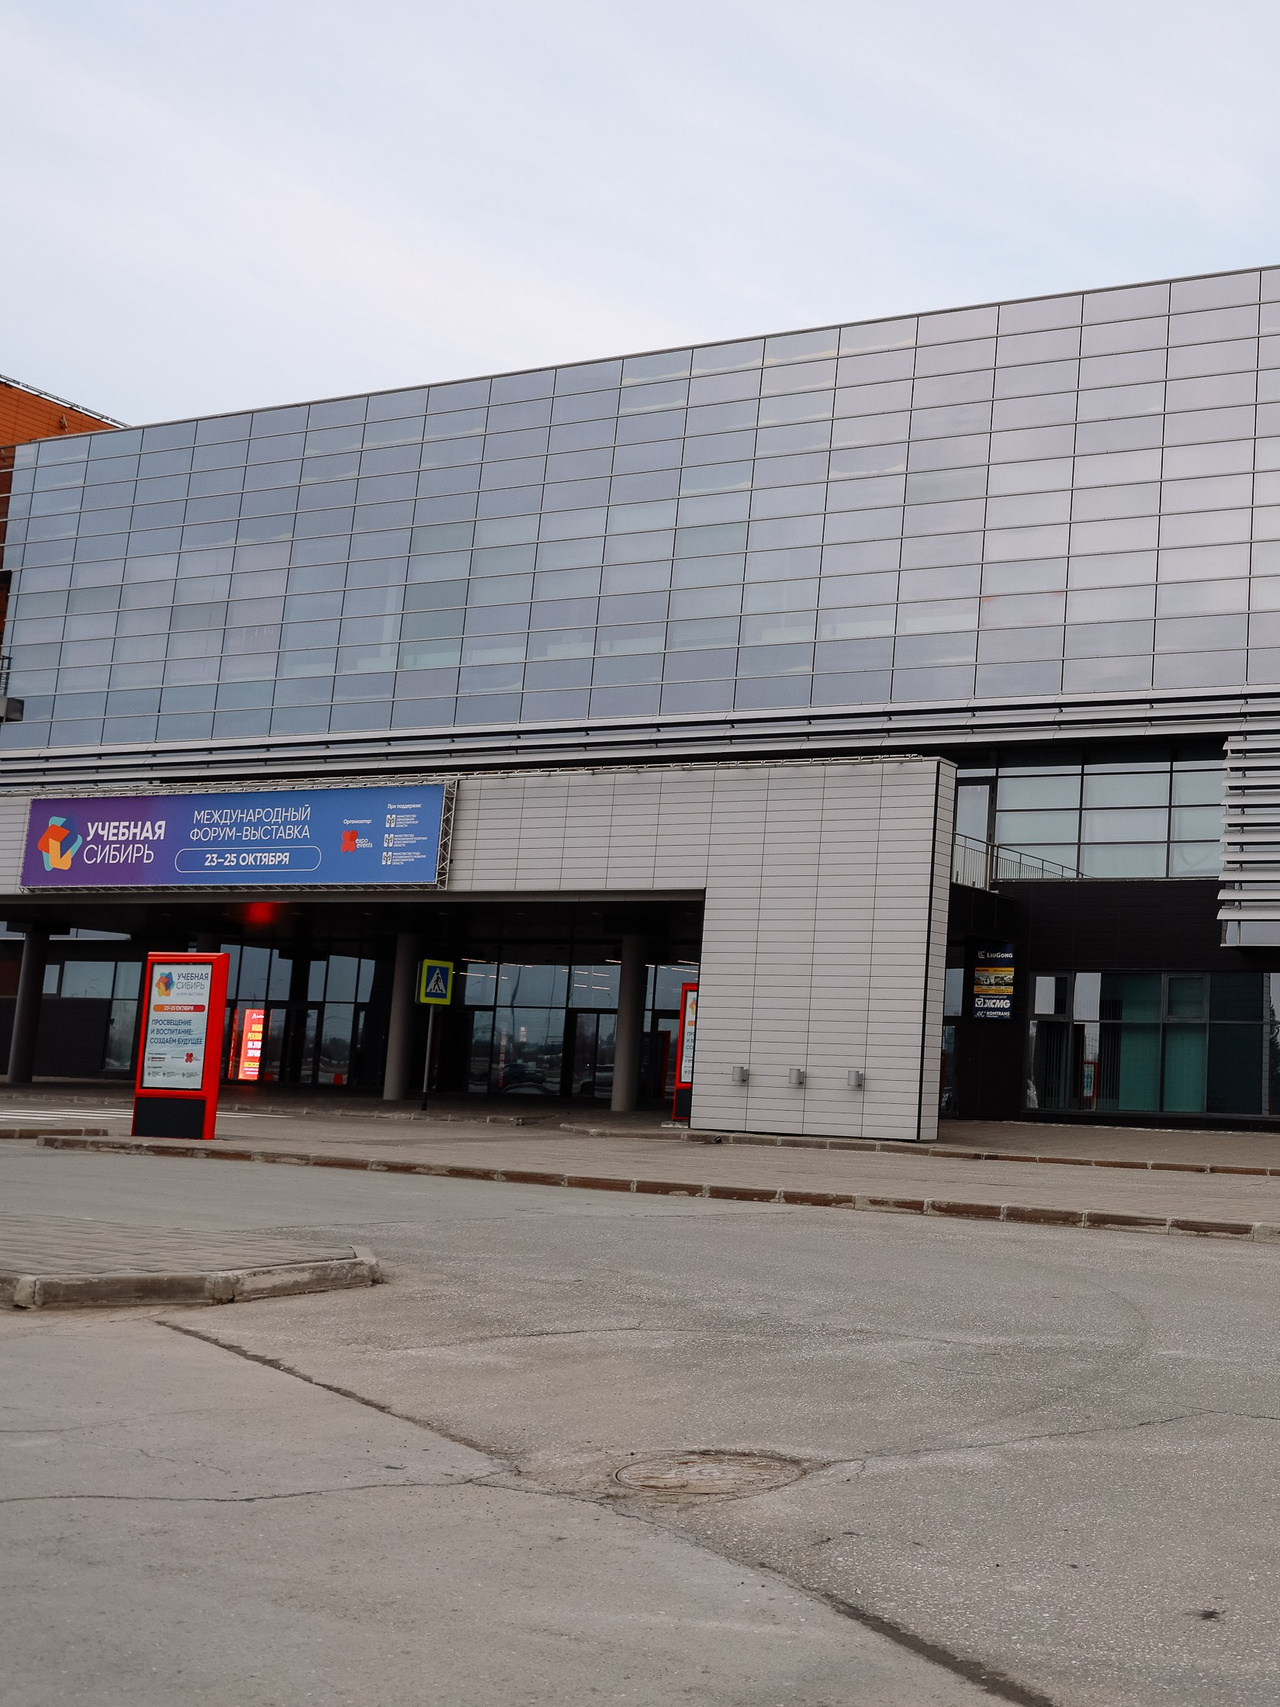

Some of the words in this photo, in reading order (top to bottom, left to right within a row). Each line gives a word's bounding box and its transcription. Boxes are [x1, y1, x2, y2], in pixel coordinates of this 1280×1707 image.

[193, 804, 311, 825] МЕЖДУНАРОДНЫЙ
[86, 820, 166, 841] УЧЕБНАЯ
[189, 825, 311, 841] ФОРУМ-ВЫСТАВКА
[83, 843, 154, 864] СИБИРЬ
[239, 852, 290, 866] ОКТЯБРЯ
[177, 972, 209, 980] УЧЕБНАЯ
[983, 999, 1011, 1008] XCMG
